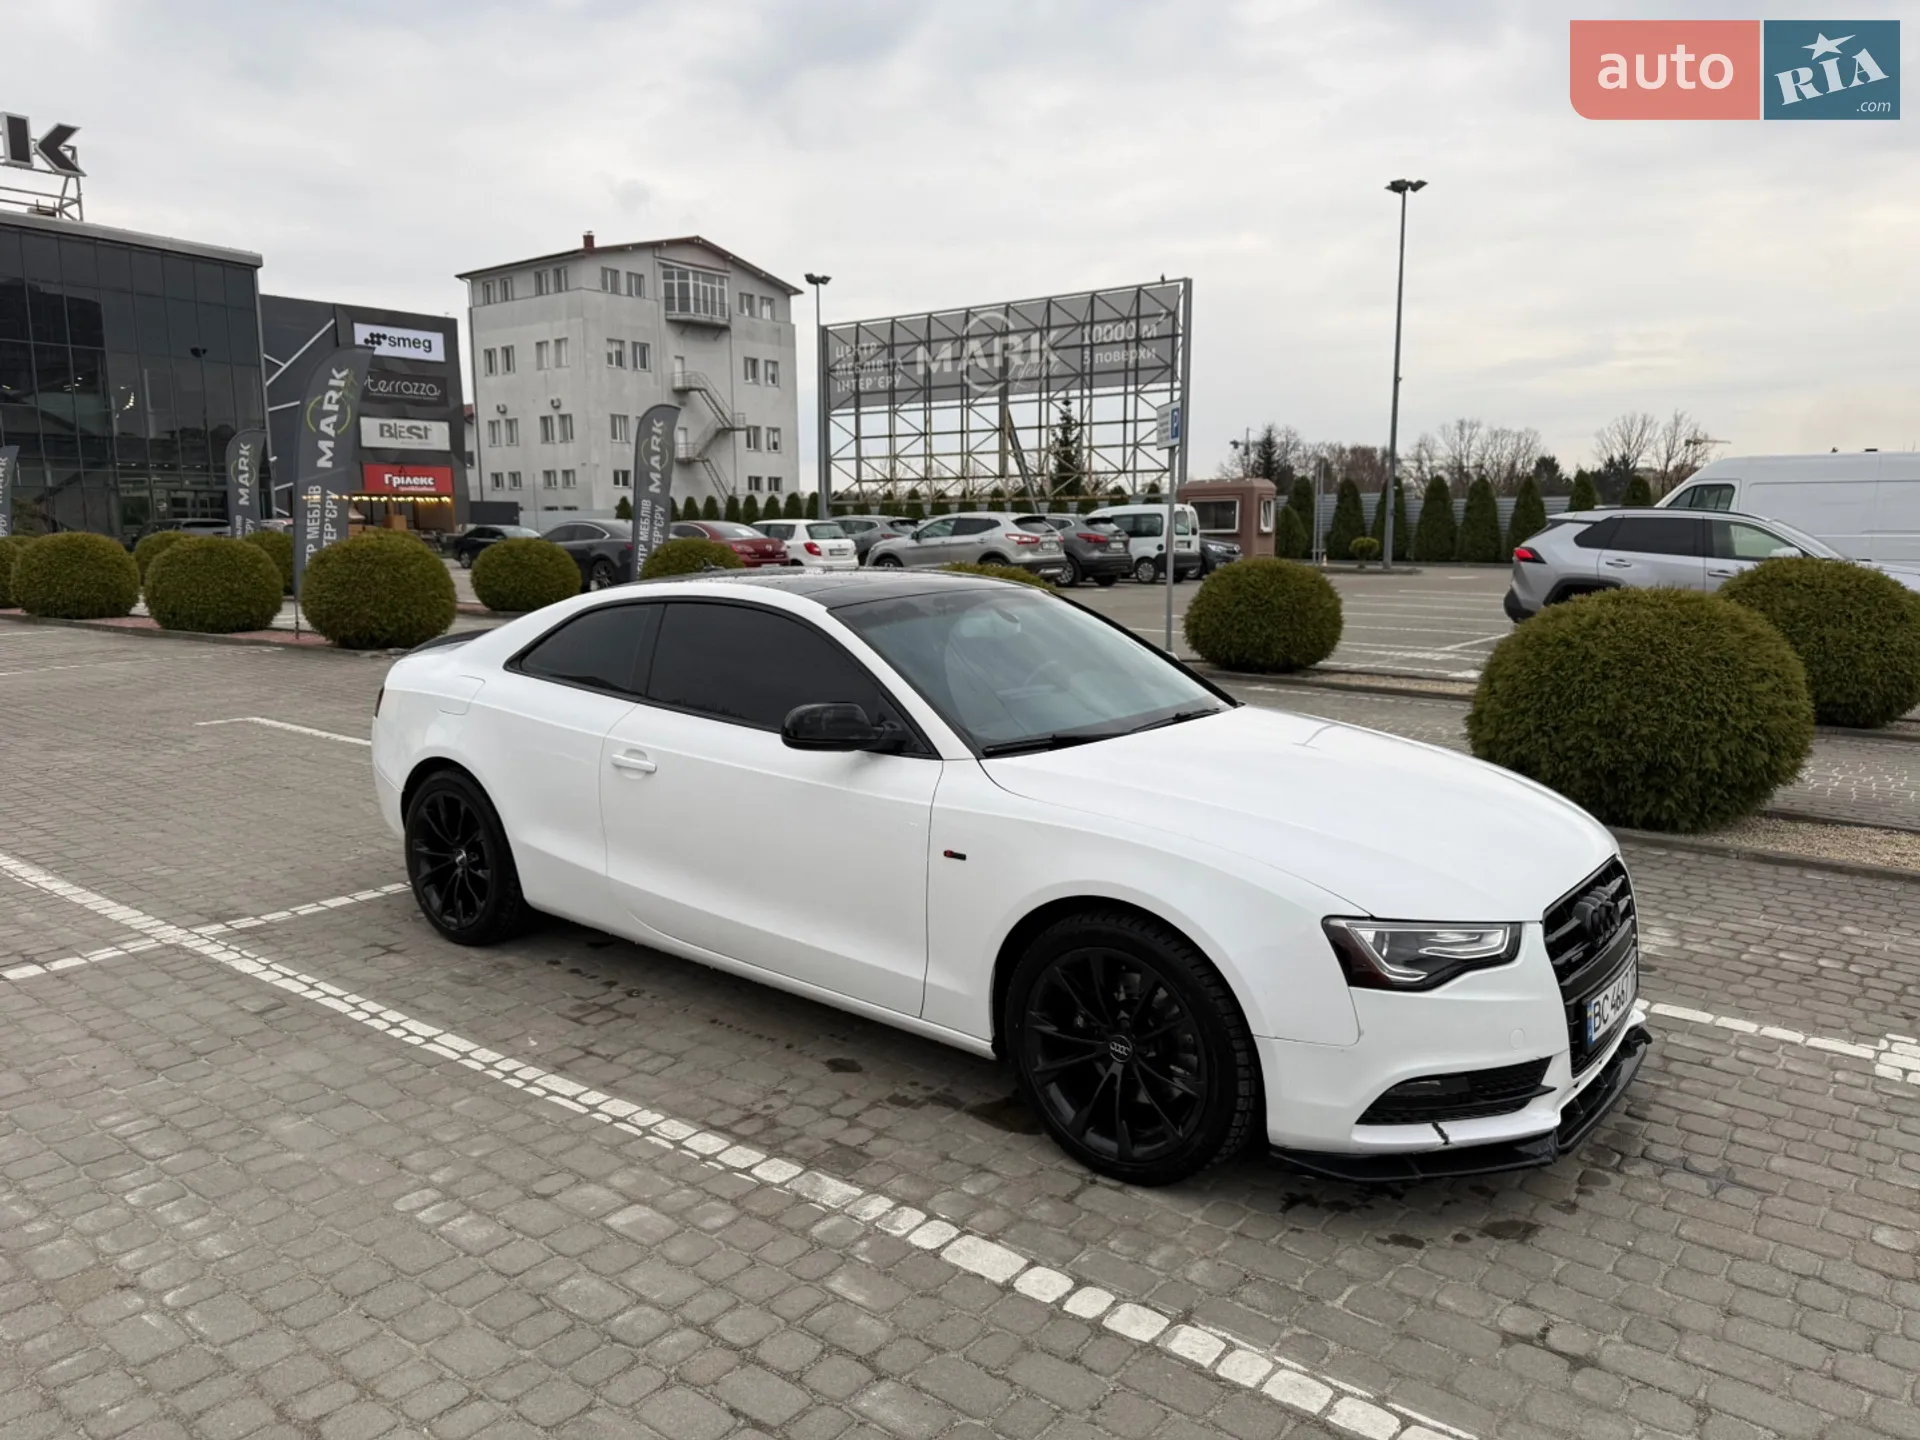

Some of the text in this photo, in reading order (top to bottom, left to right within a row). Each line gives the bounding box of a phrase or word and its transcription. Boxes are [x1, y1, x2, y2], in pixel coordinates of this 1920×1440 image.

[388, 335, 432, 353] smeg
[916, 331, 1060, 376] MARK
[1095, 347, 1156, 364] поверхи
[316, 367, 349, 469] MARK
[238, 442, 251, 506] MARK
[648, 417, 664, 494] MARK
